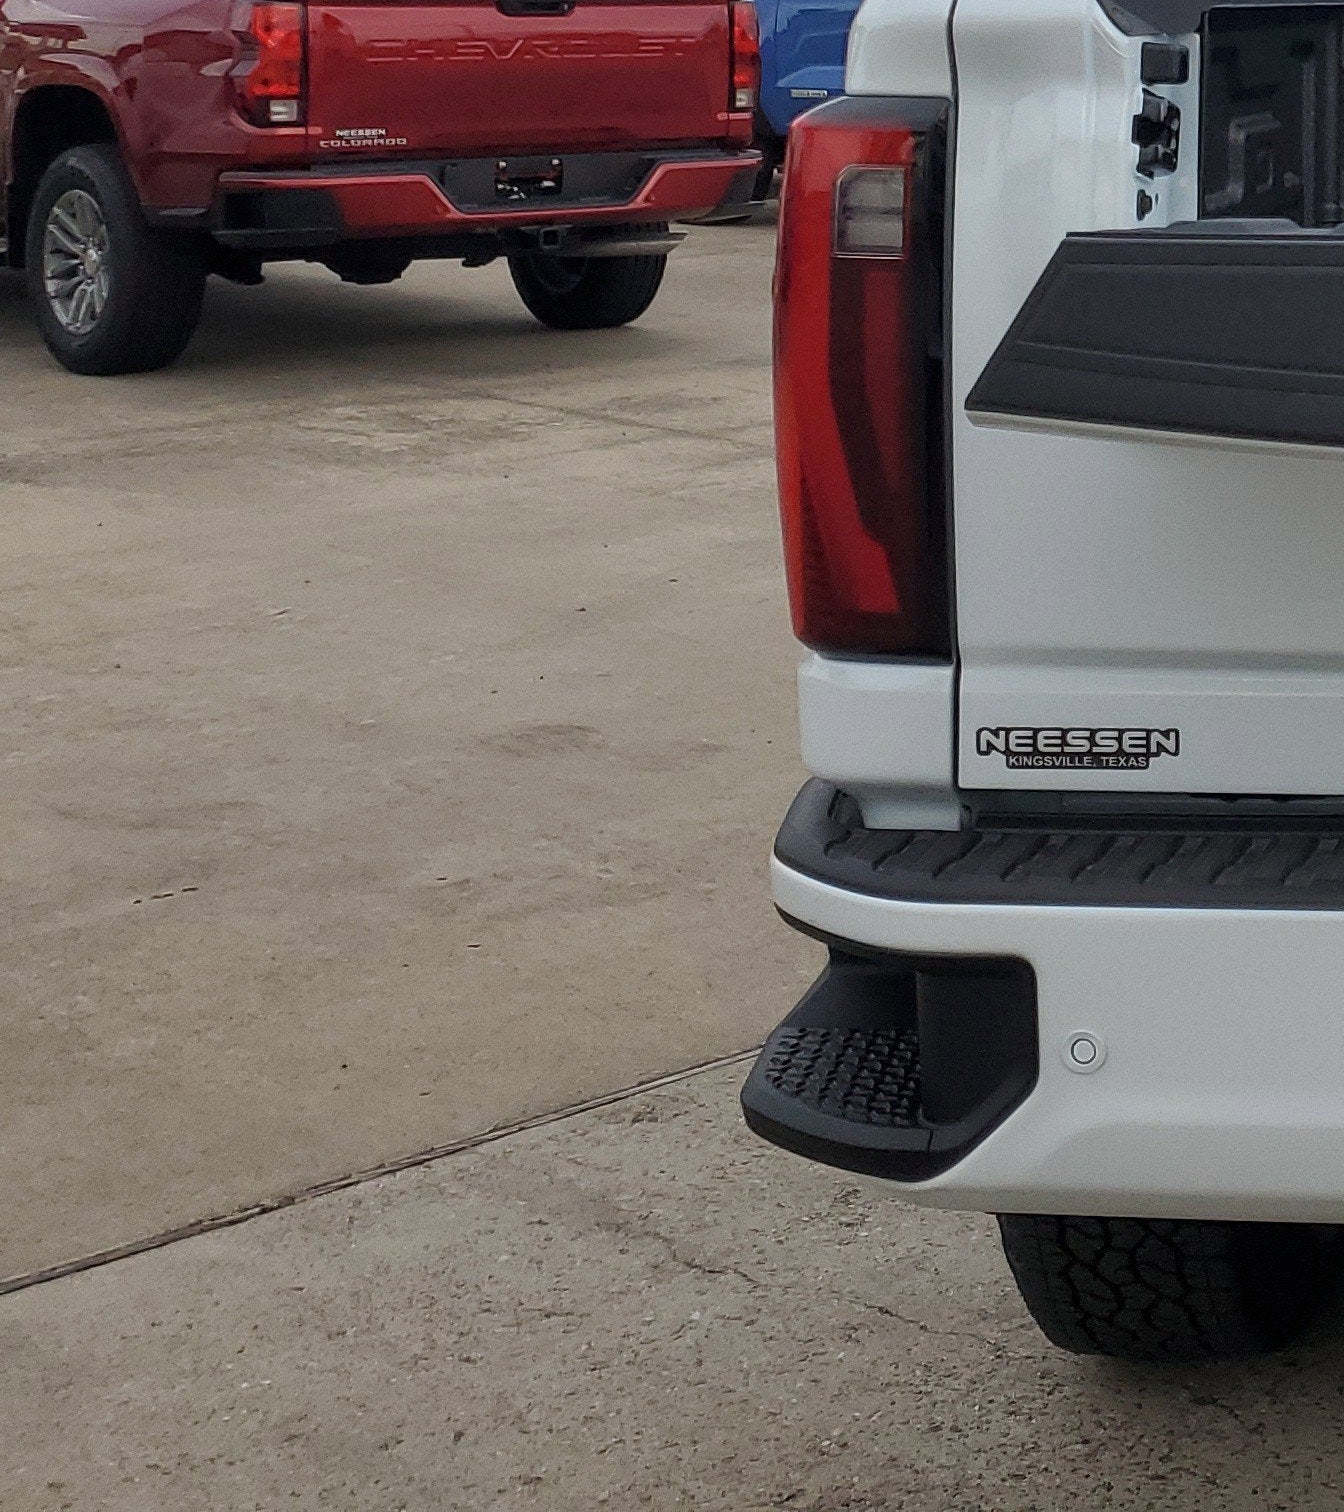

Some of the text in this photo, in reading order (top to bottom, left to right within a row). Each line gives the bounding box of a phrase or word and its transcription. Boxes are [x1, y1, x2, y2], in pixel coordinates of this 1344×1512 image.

[365, 38, 699, 63] CHEVROLET
[319, 137, 408, 148] COLORADO
[979, 729, 1177, 755] NEESSEN
[1008, 754, 1148, 768] KINGSVILLE, TEXAS
